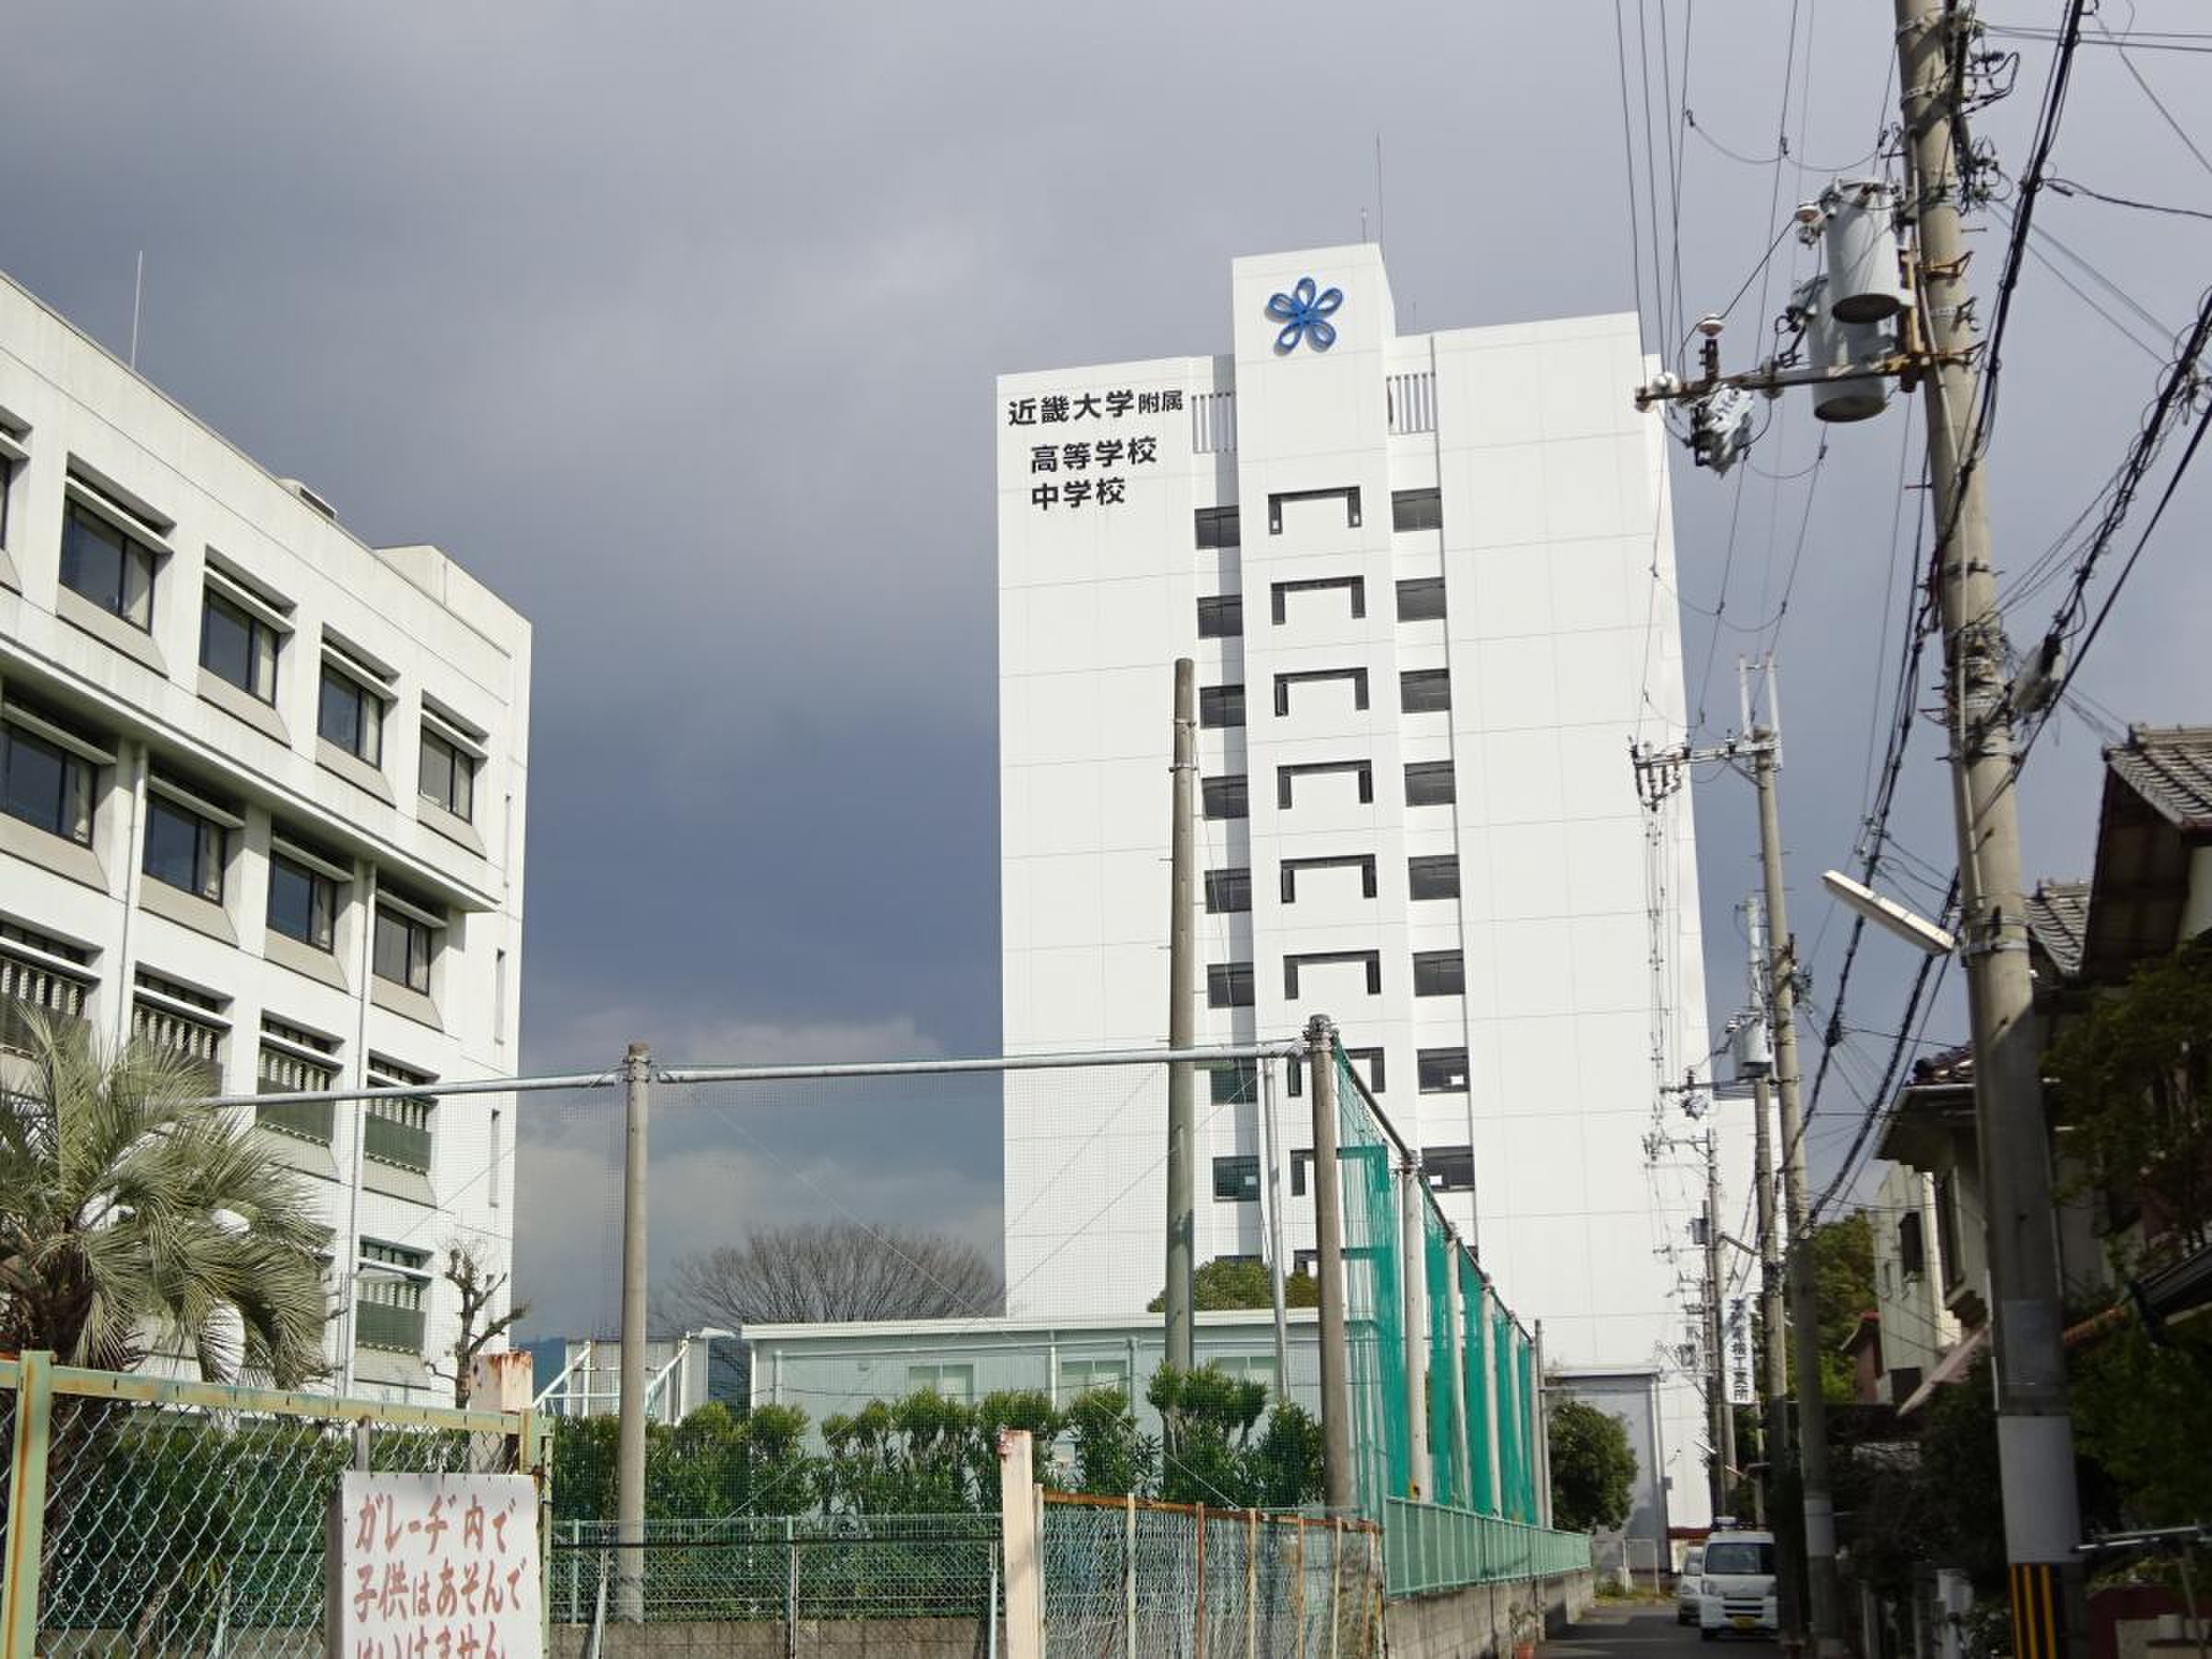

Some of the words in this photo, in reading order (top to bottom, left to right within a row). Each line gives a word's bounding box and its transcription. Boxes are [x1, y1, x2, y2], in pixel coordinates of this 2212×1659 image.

[1008, 389, 1182, 427] 近畿大学附属
[1030, 436, 1158, 475] 高等学校
[1030, 477, 1125, 511] 中学校
[353, 1556, 527, 1622] 子供はあそんで
